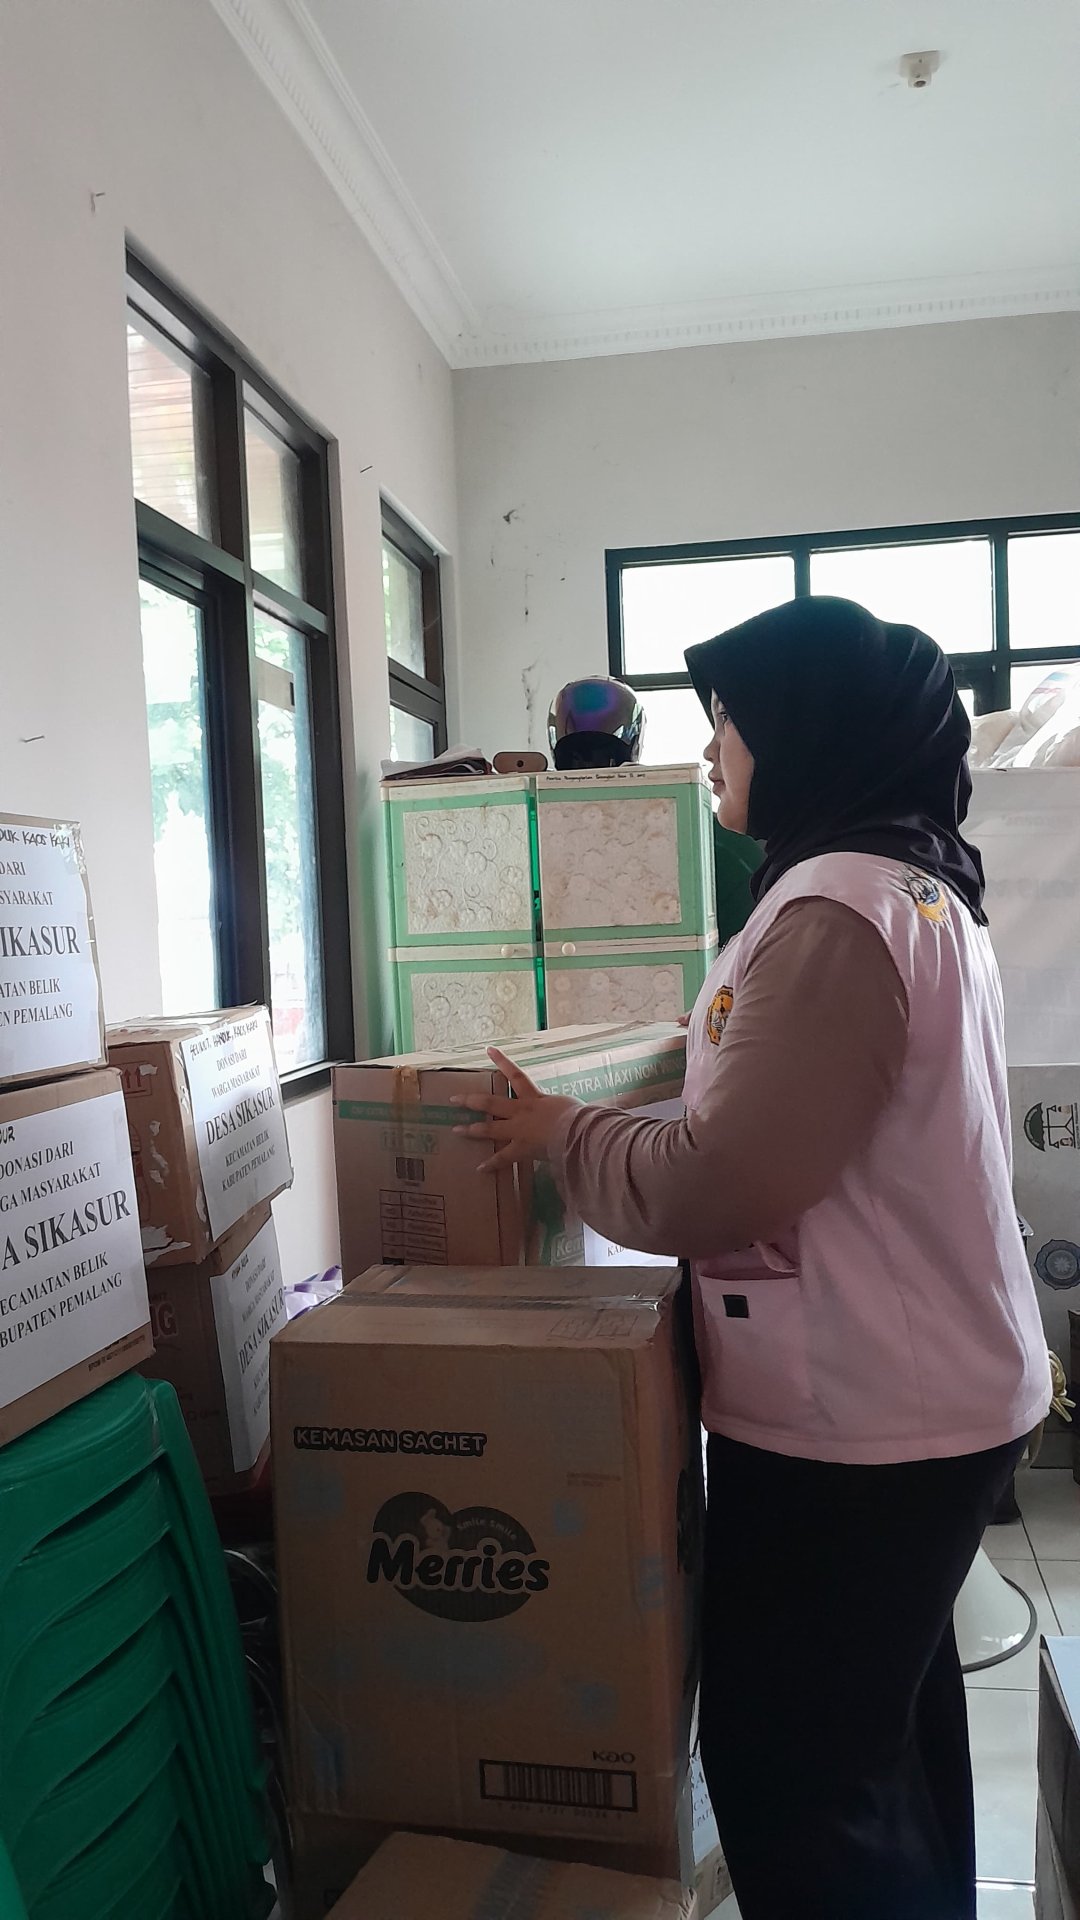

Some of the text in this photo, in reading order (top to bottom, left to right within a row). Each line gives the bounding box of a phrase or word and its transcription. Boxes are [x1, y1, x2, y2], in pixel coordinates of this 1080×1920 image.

[0, 861, 26, 875] DARI
[0, 890, 53, 905] SYARAKAT
[0, 926, 80, 957] IKASUR
[29, 978, 61, 995] BELIK
[14, 1003, 73, 1025] PEMALANG
[562, 1077, 603, 1096] EXTRA
[604, 1067, 633, 1088] MAXI
[634, 1063, 659, 1081] NON
[205, 1086, 275, 1145] DESA SIKASUR
[45, 1140, 74, 1164] DARI
[20, 1162, 101, 1206] MASYARAKAT
[2, 1189, 131, 1271] A SIKASUR
[0, 1251, 109, 1316] ECAMATAN BELIK
[0, 1272, 122, 1348] BUPATEN PEMALANG
[296, 1429, 485, 1452] KEMASAN SACHET
[366, 1537, 551, 1592] Merries
